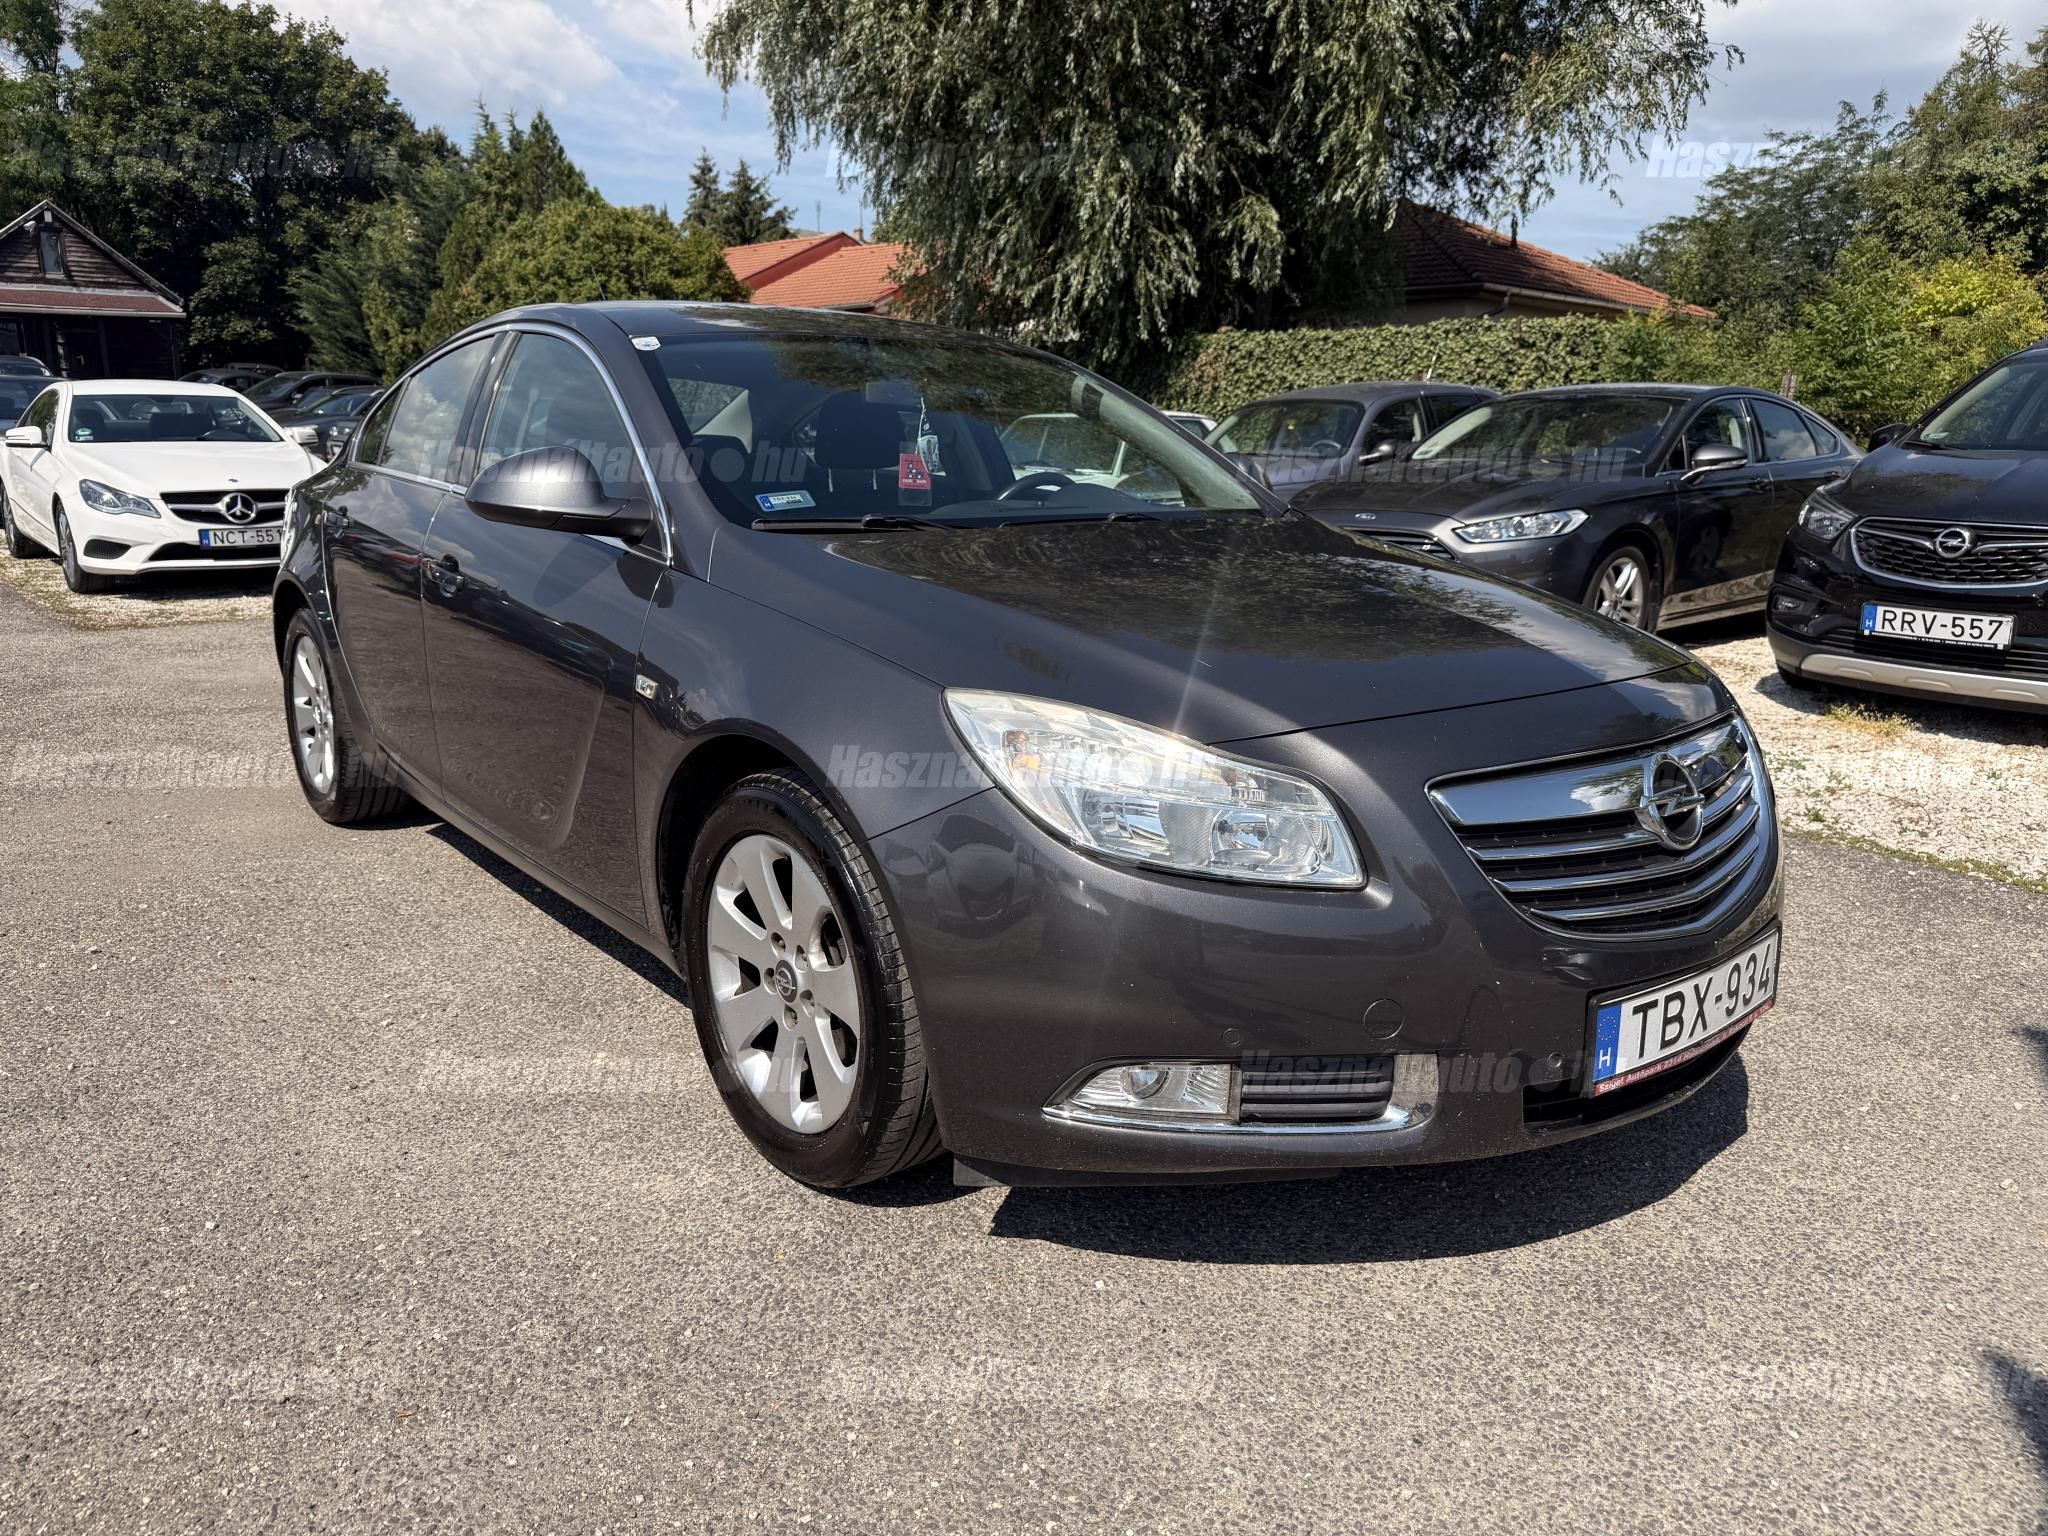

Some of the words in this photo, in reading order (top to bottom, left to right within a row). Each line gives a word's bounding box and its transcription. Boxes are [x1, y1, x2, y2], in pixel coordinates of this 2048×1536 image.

[1865, 619, 1873, 628] H
[1881, 609, 2004, 641] RRV-557
[1632, 943, 1771, 1059] TBX-934
[1598, 1047, 1612, 1070] H
[1599, 1076, 1625, 1093] Sziget
